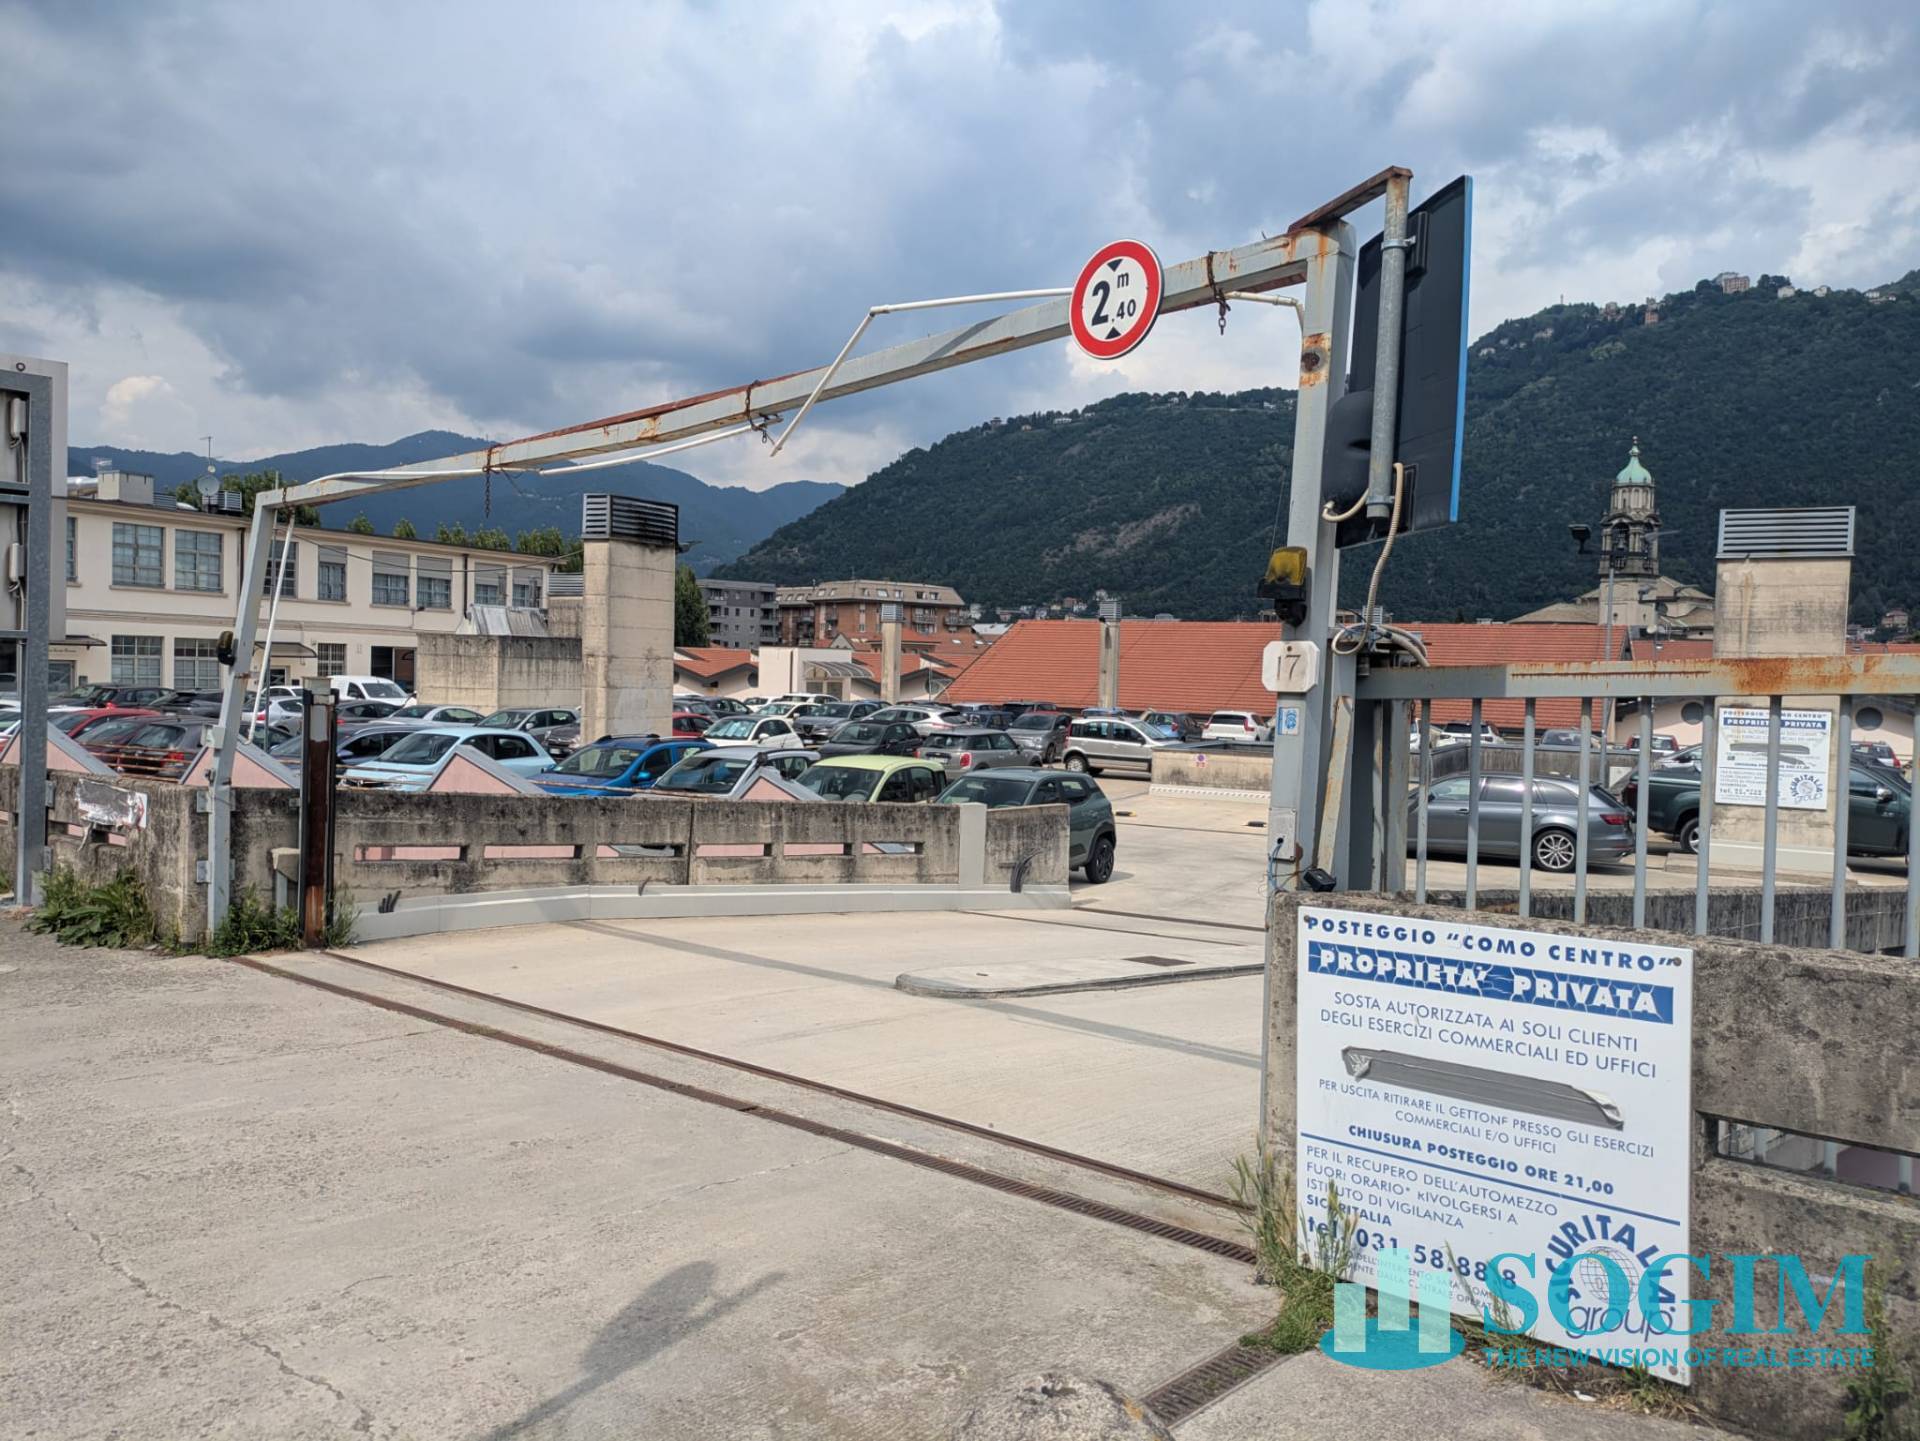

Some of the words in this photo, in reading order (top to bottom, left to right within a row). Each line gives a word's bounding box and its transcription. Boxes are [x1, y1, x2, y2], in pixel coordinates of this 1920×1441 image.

[1117, 272, 1130, 288] m
[1276, 654, 1301, 680] 17
[1784, 720, 1823, 728] PRIVATA
[1307, 916, 1436, 945] POSTEGGIO
[1513, 974, 1658, 1015] PRIVATA
[1320, 1008, 1363, 1028] DEGLI
[1368, 1017, 1432, 1040] ESERCIZI
[1438, 1029, 1558, 1062] COMMERCIALI
[1565, 1050, 1588, 1066] ED
[1596, 1055, 1657, 1078] UFFICI
[1334, 991, 1381, 1011] SOSTA
[1386, 1000, 1494, 1029] AUTORIZZATA
[1499, 1018, 1514, 1033] AI
[1522, 1020, 1561, 1040] SOLI
[1568, 1028, 1638, 1052] CLIENTI
[1319, 1078, 1337, 1091] PER
[1340, 1083, 1380, 1101] USCITA
[1384, 1092, 1431, 1112] RITIRARE
[1435, 1103, 1445, 1114] IL
[1512, 1118, 1562, 1138] PRESSO
[1567, 1130, 1589, 1144] GLI
[1594, 1135, 1655, 1158] ESERCIZI
[1395, 1110, 1481, 1138] COMMERCIALI
[1485, 1129, 1510, 1144] E/O
[1514, 1135, 1557, 1154] UFFICI
[1307, 1145, 1328, 1160] PER
[1333, 1151, 1342, 1164] IL
[1347, 1155, 1418, 1181] RECUPERO
[1423, 1174, 1558, 1216] DELL'AUTOMEZZO
[1349, 1125, 1422, 1151] CHIUSURA
[1427, 1142, 1518, 1173] POSTEGGIO
[1525, 1165, 1558, 1183] ORE
[1564, 1174, 1614, 1195] 21,00
[1307, 1162, 1346, 1180] FUORI
[1507, 1213, 1518, 1225] A
[1307, 1177, 1363, 1201] ISTIUTO
[1368, 1194, 1382, 1207] DI
[1386, 1198, 1464, 1229] VIGILANZA
[1307, 1194, 1392, 1226] SICRITALIA
[1566, 1306, 1674, 1342] group
